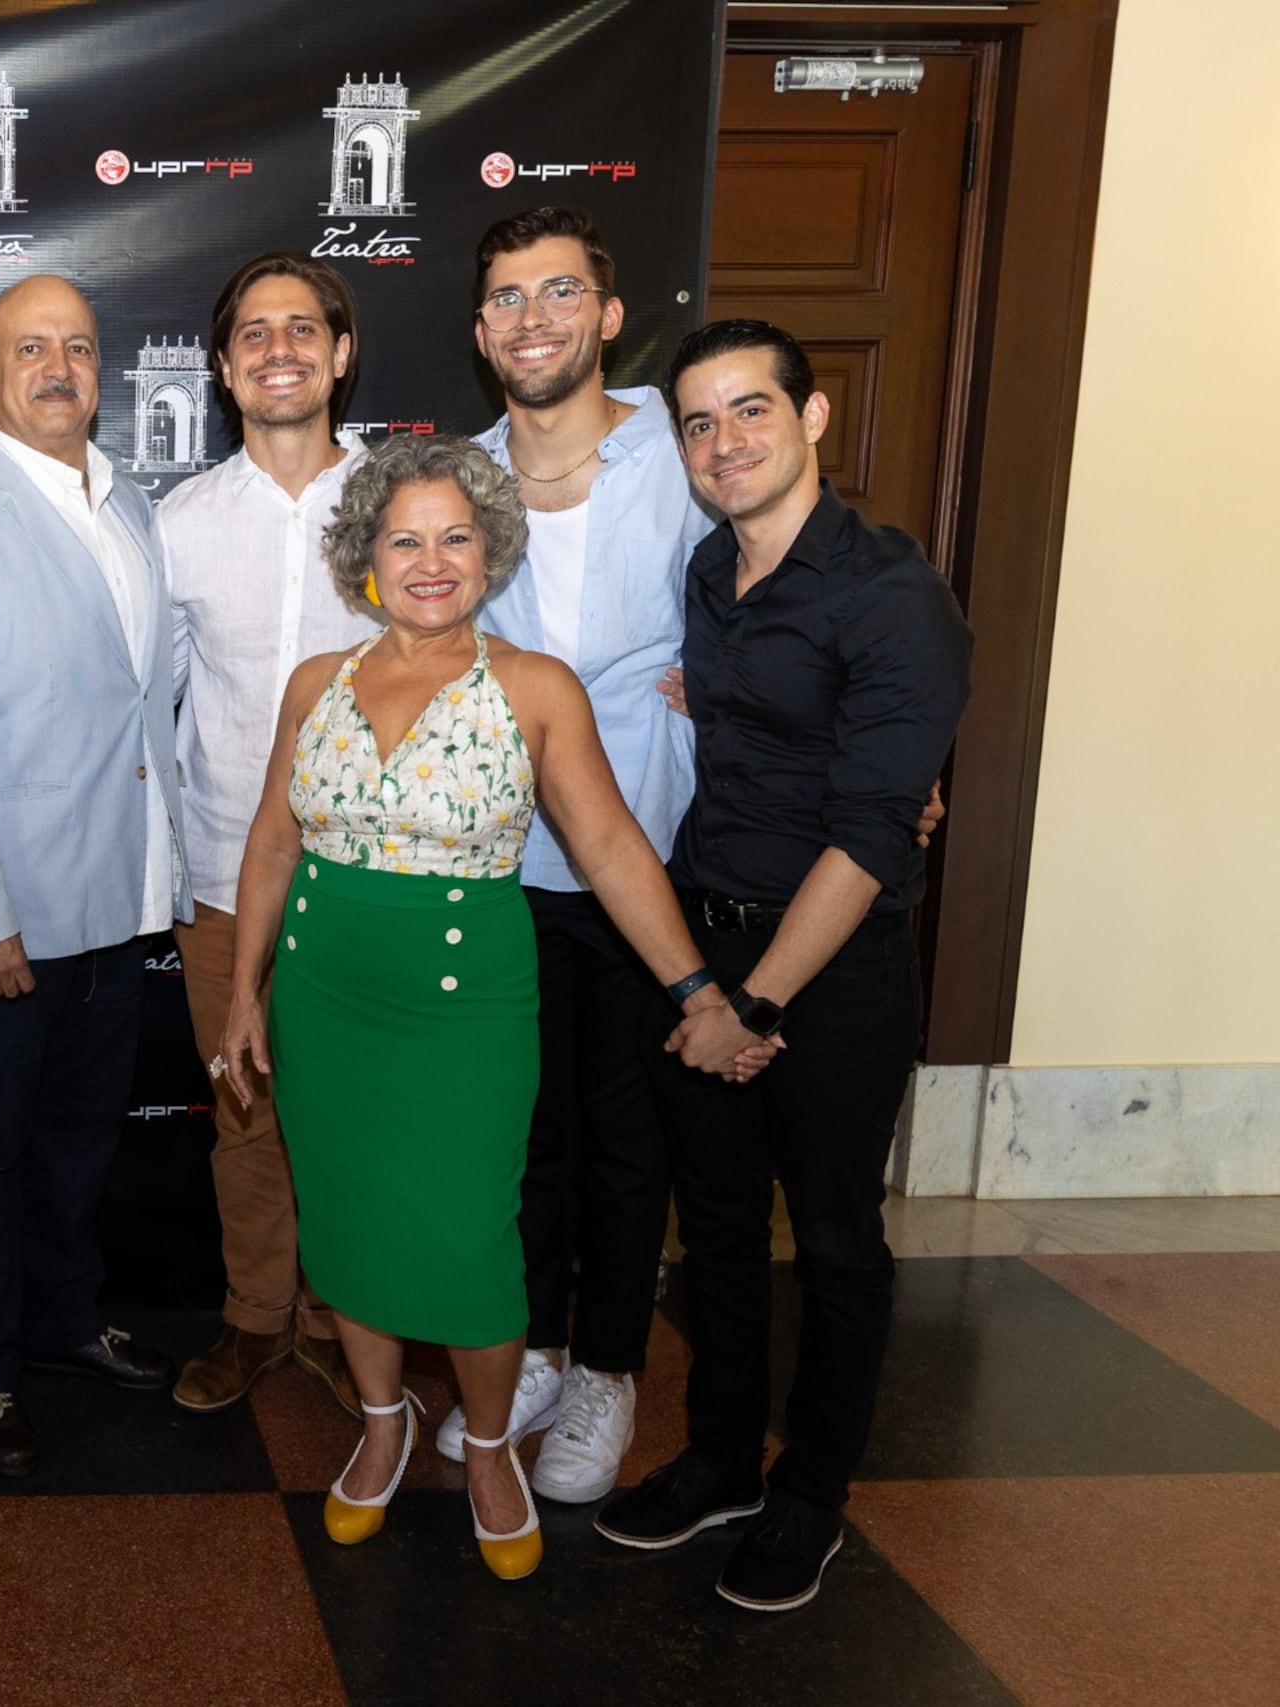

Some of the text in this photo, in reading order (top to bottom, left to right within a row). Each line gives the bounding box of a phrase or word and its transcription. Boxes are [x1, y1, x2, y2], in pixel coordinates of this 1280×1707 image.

[133, 160, 253, 179] uprrp
[517, 163, 636, 183] uprrp
[310, 221, 422, 258] Teatro
